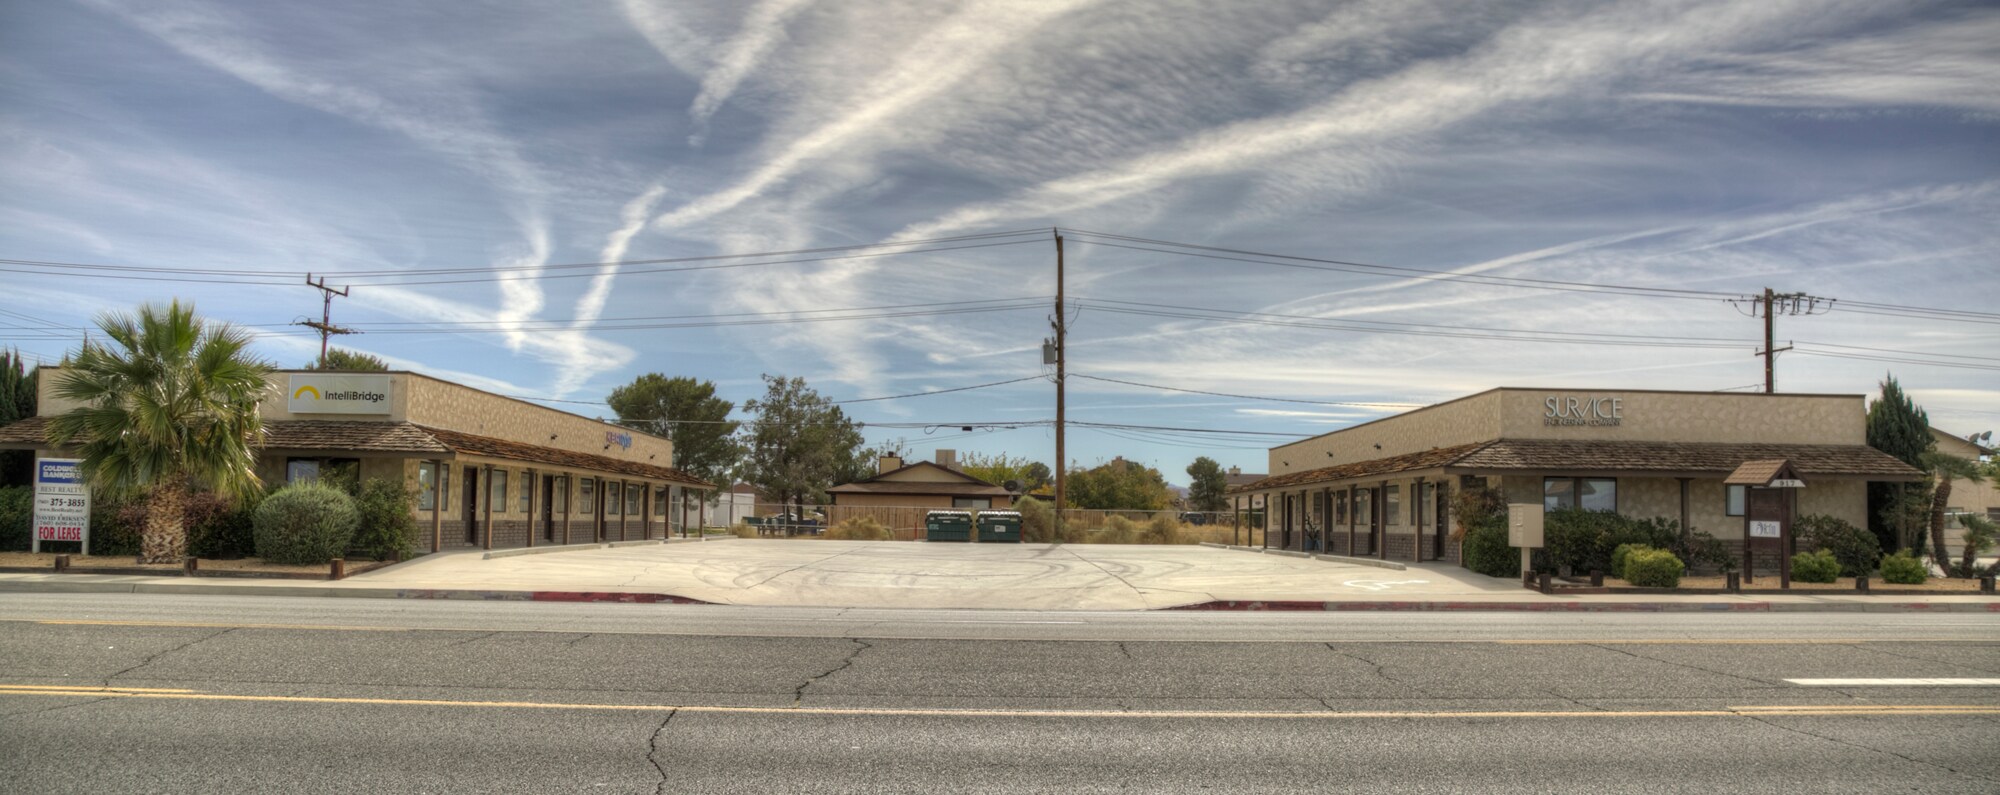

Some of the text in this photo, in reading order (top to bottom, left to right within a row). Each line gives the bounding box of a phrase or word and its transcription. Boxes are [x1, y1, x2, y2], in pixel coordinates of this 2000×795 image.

[325, 391, 385, 403] IntelliBridge
[1545, 396, 1623, 418] SURVICE
[43, 471, 75, 480] BANKER
[50, 498, 85, 507] 375-3855
[38, 527, 81, 540] FOR LEASE
